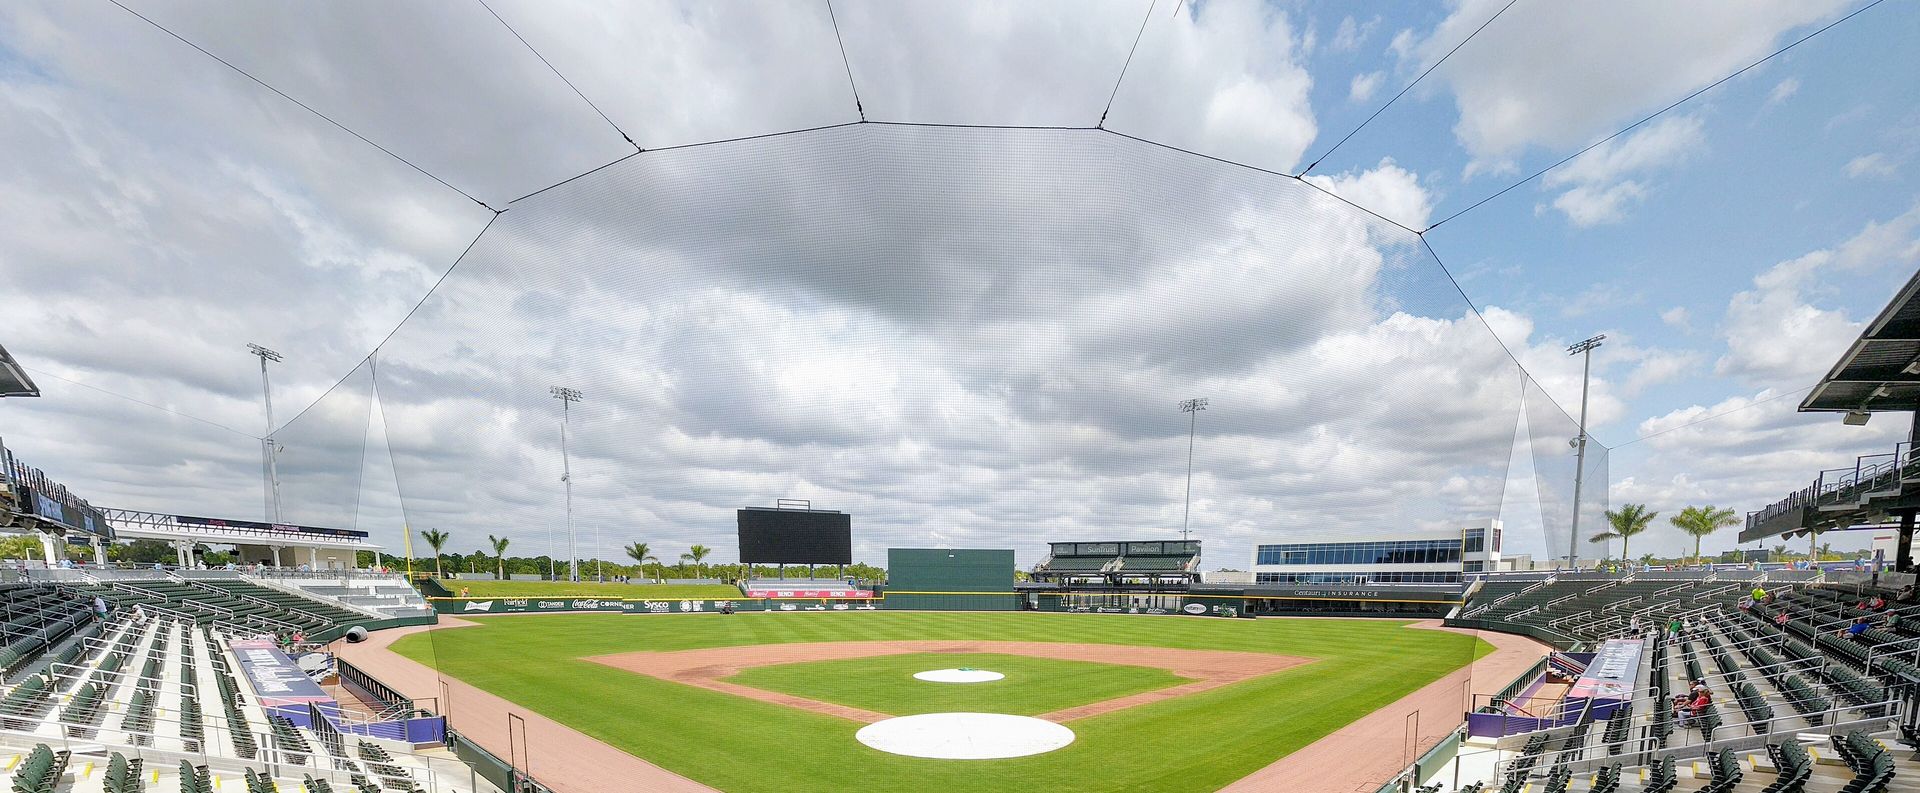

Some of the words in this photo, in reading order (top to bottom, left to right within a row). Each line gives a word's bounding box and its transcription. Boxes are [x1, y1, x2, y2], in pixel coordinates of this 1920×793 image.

[1087, 546, 1116, 554] SunTrust
[1131, 545, 1160, 553] Pavilion
[644, 600, 669, 610] Sysco
